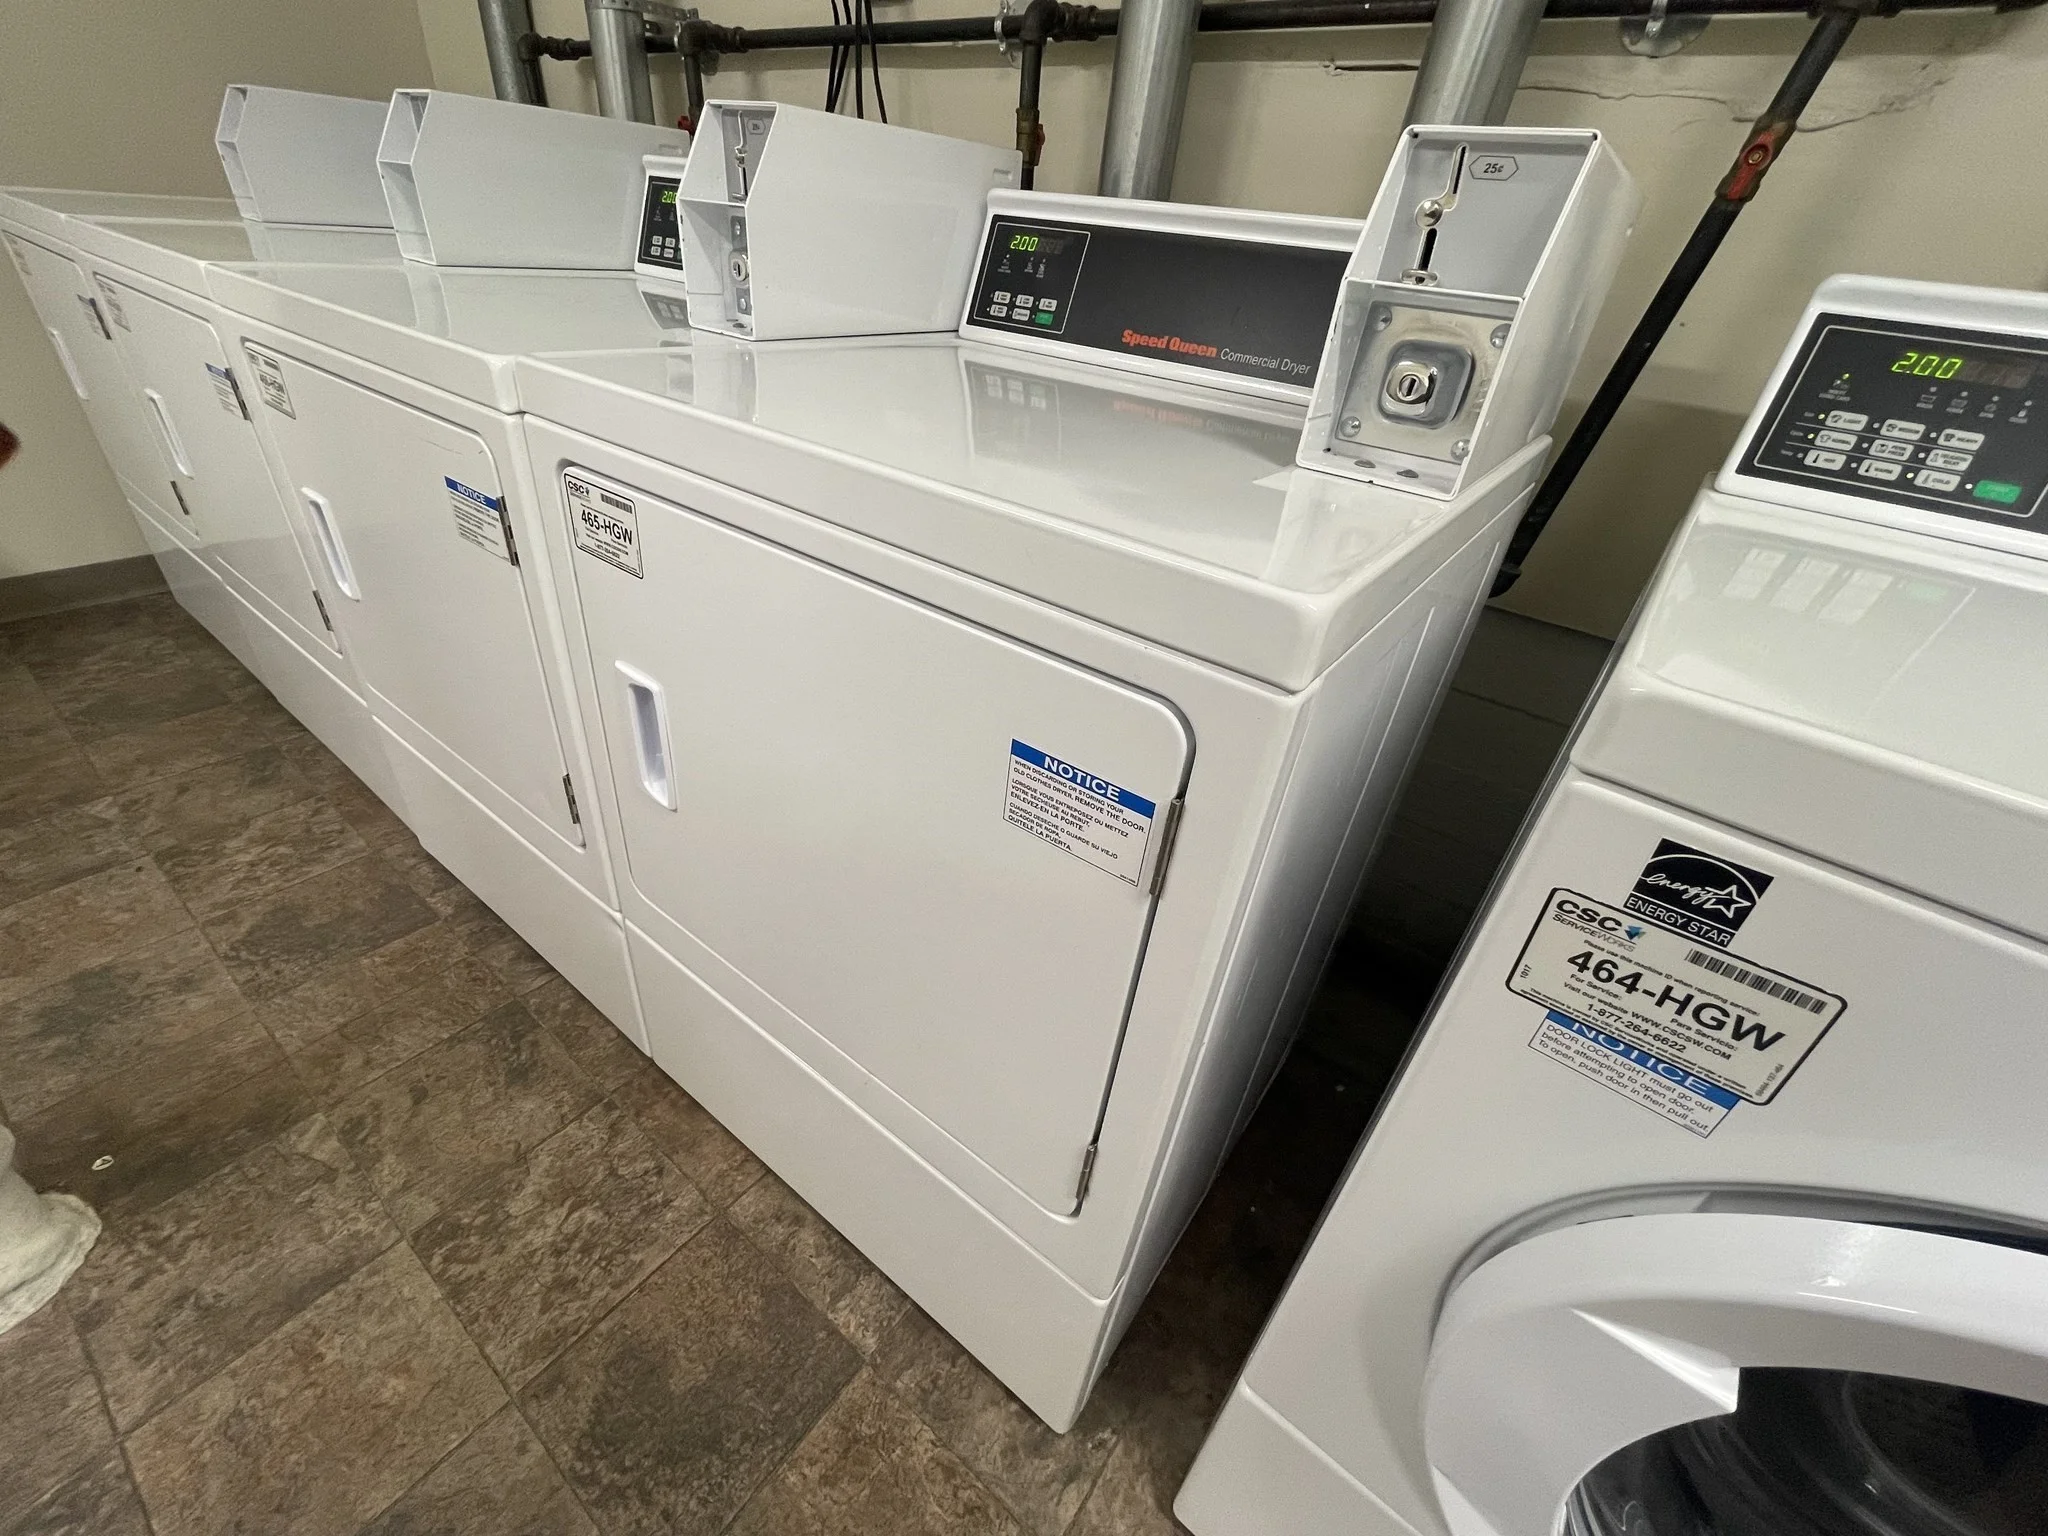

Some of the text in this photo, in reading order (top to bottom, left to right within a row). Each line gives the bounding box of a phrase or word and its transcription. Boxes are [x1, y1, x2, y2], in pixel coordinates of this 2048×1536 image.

[1483, 163, 1504, 174] 25¢
[1010, 235, 1038, 251] 2.00
[1122, 329, 1311, 375] Speed Queen Commercial Dryer
[1891, 352, 1963, 379] 2.00
[457, 483, 486, 504] NOTICE
[568, 481, 584, 494] CSC
[581, 509, 632, 545] 465-HGW
[1014, 760, 1123, 814] WHEN DISCARDING OR STORING YOUR
[1044, 756, 1120, 801] NOTICE
[1009, 808, 1035, 824] SECADOR
[1011, 784, 1029, 796] VOTRE
[1061, 809, 1069, 817] AU
[1012, 778, 1129, 838] LORSQUE VOUS ENTREPOSEZ OU METTEZ
[1013, 767, 1025, 776] OLD
[1026, 772, 1051, 789] CLOTHES
[1075, 795, 1104, 814] REMOVE
[1106, 809, 1120, 821] THE
[1122, 817, 1146, 833] DOOR.
[1050, 811, 1059, 819] LA
[1008, 814, 1034, 831] QUITELE
[1035, 828, 1044, 837] LA
[1009, 802, 1032, 817] CUANDO
[1033, 814, 1060, 831] DESECHE
[1066, 830, 1090, 846] GUARDE
[1091, 842, 1100, 850] SU
[1101, 847, 1118, 860] VIEJO
[1641, 873, 1714, 905] energy
[1556, 900, 1622, 932] CSC
[1626, 896, 1731, 946] ENERGY STAR
[1520, 964, 1532, 980] 1017
[1570, 973, 1622, 1001] For Service:
[1584, 939, 1605, 952] Please
[1606, 949, 1618, 958] use
[1619, 953, 1633, 964] this
[1633, 960, 1663, 977] machine
[1664, 972, 1673, 980] ID
[1674, 976, 1693, 989] when
[1694, 985, 1728, 1004] reporting
[1567, 950, 1786, 1052] 464-HGW
[1563, 982, 1732, 1061] Visit our website WWW.CSCSW.COM
[1586, 1003, 1687, 1054] 1-877-264-6622
[1670, 1018, 1738, 1052] Para Servicio:
[1538, 1039, 1549, 1050] To
[1578, 1060, 1604, 1078] push
[1605, 1073, 1630, 1091] door
[1630, 1086, 1641, 1096] in
[1642, 1093, 1666, 1109] then
[1667, 1106, 1689, 1122] pull
[1689, 1118, 1709, 1133] out.
[1541, 1031, 1695, 1115] before attempting to open door.
[1546, 1024, 1714, 1113] DOOR LOCK LIGHT must go out
